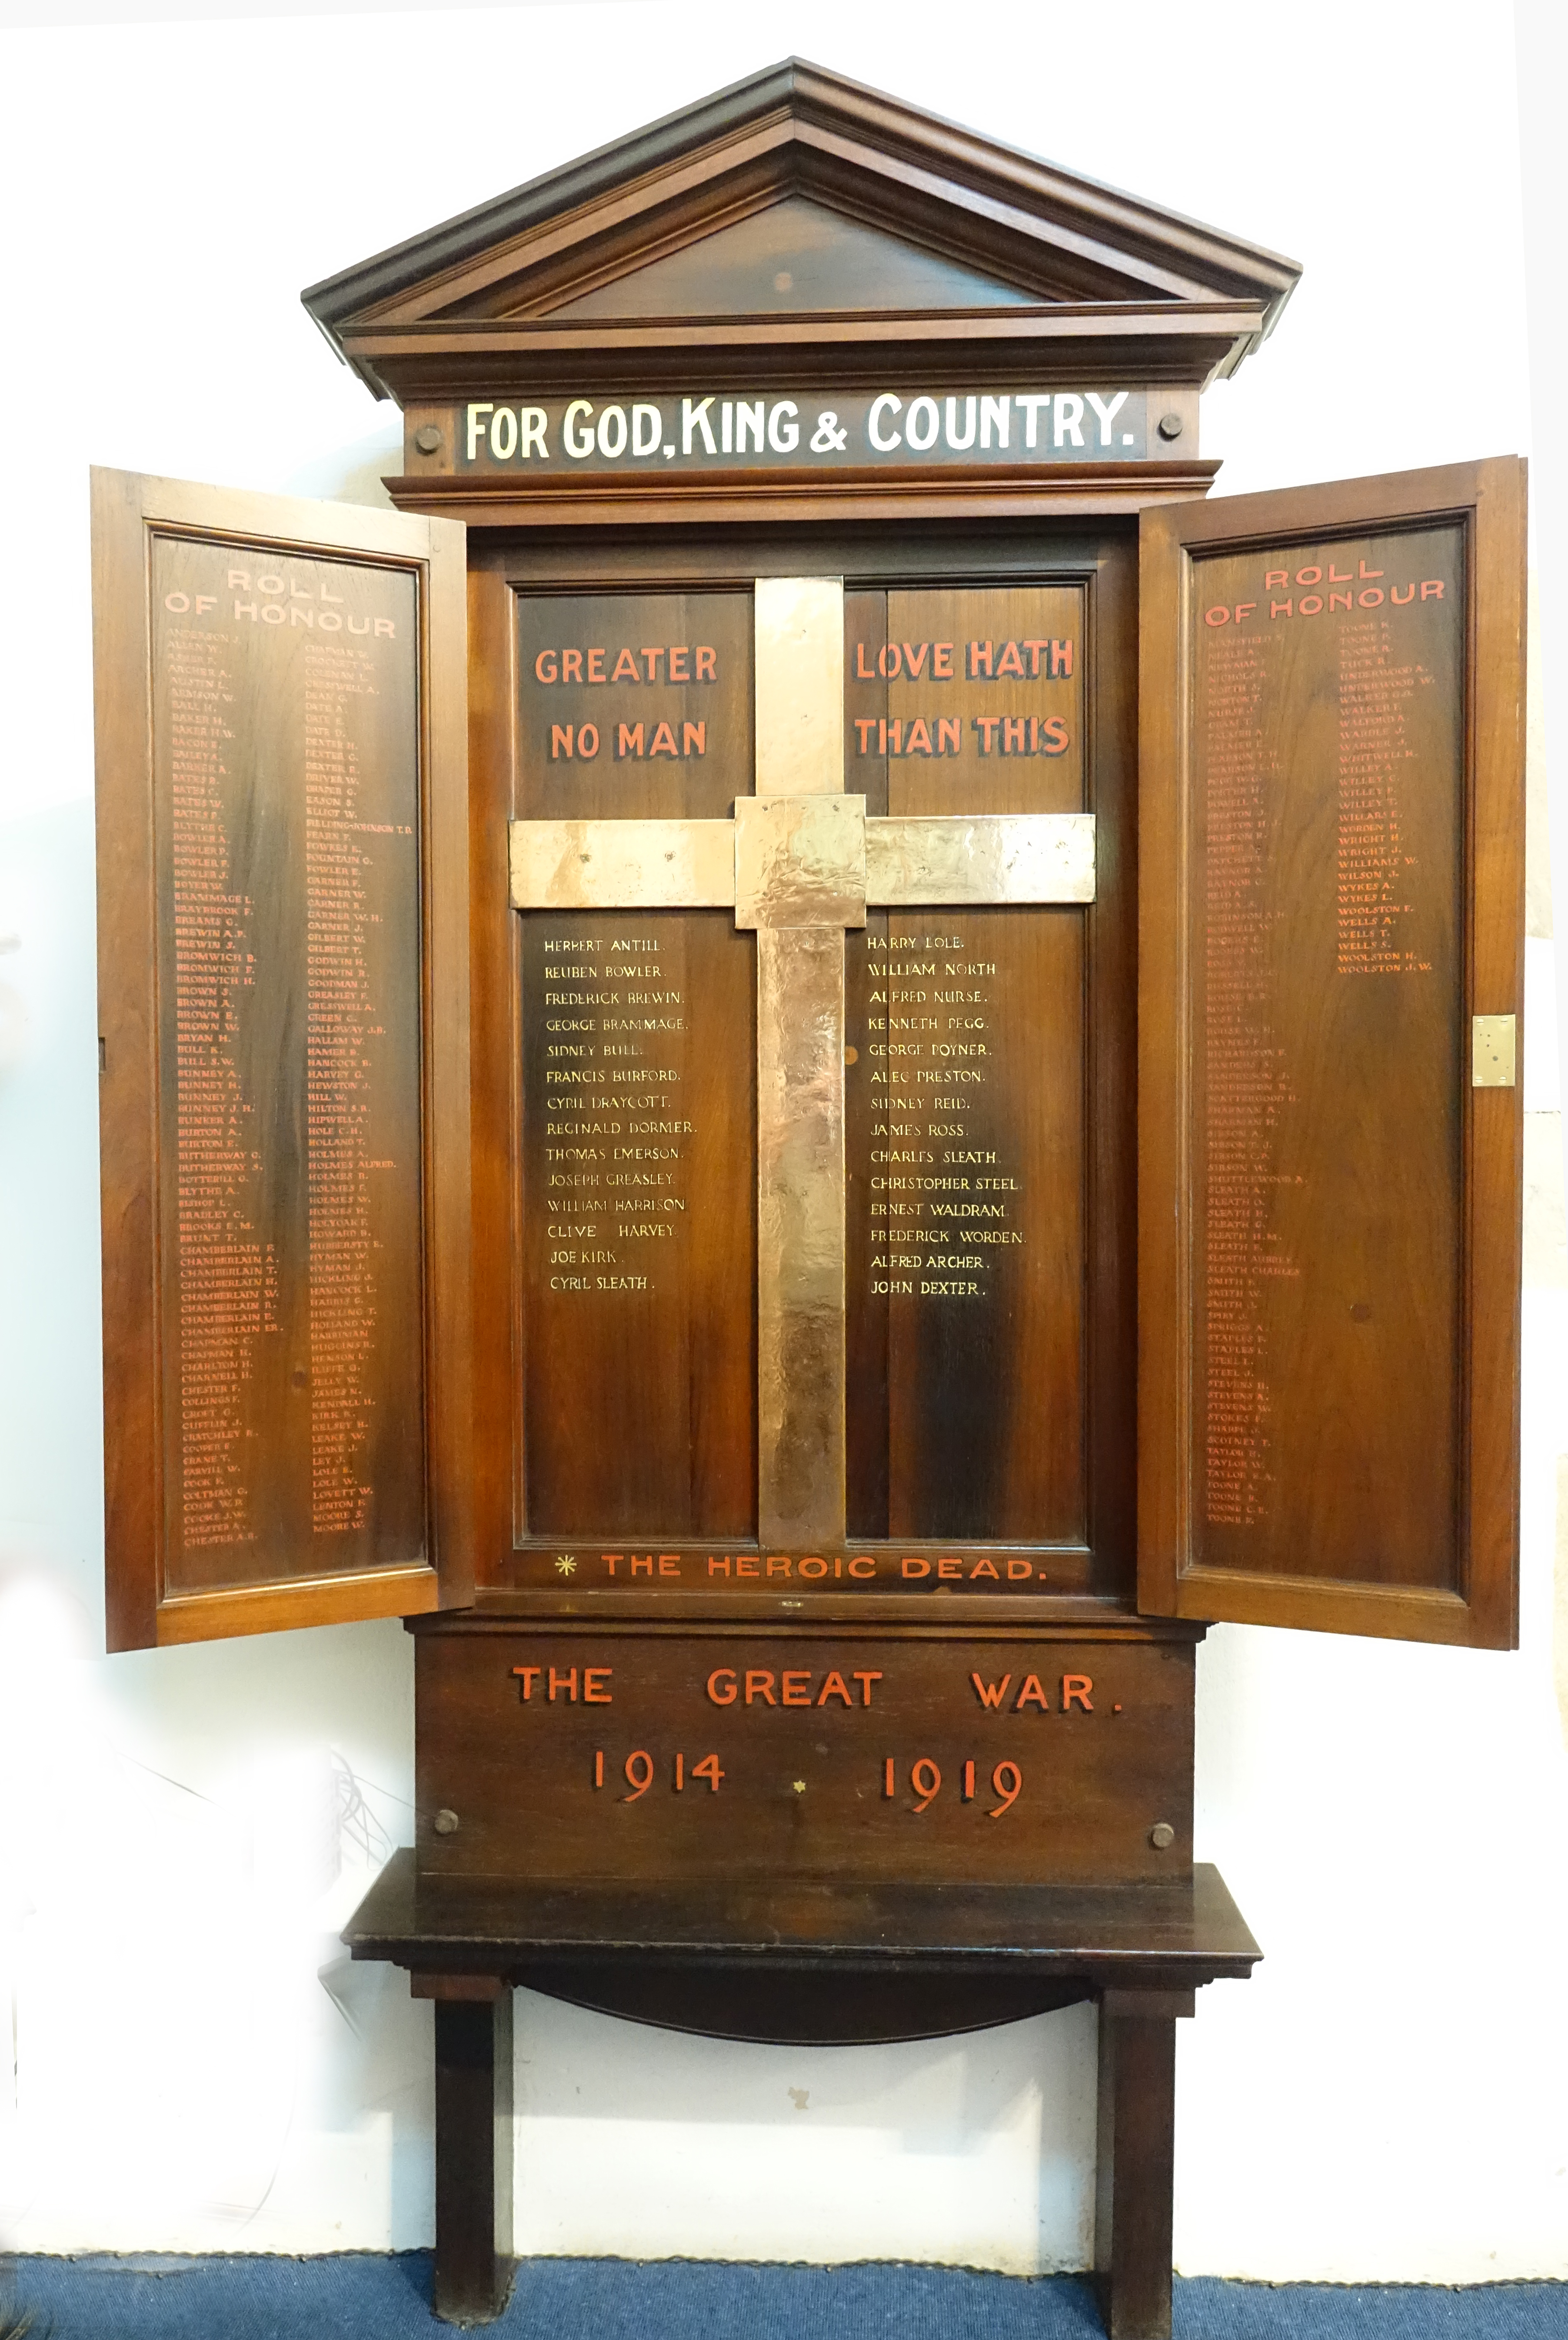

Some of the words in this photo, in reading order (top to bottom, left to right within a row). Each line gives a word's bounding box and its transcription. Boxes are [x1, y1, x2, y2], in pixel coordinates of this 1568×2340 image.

[467, 403, 550, 459] FOR
[682, 397, 800, 455] KING
[811, 411, 848, 453] &
[865, 392, 1135, 452] COUNTRY.
[1265, 559, 1384, 590] ROLL
[227, 570, 344, 603] ROLL
[1204, 603, 1256, 627] OF
[1270, 580, 1445, 619] HONOUR
[164, 592, 217, 616] OF
[234, 600, 396, 639] HONOUR
[535, 646, 717, 684] GREATER
[856, 642, 954, 679] LOVE
[970, 639, 1073, 677] HATH
[551, 723, 600, 758] NO
[618, 721, 706, 757] MAN
[854, 717, 962, 754] THAN
[977, 716, 1070, 753] THIS
[545, 940, 603, 952] HERBERT
[611, 940, 665, 951] ANTILL.
[868, 937, 916, 949] HARRY
[545, 967, 597, 979] REUBEN
[606, 966, 667, 977] BOWLER.
[868, 964, 935, 975] WILLIAM
[945, 963, 996, 975] NORTH
[546, 993, 619, 1005] FREDERICK
[628, 992, 685, 1004] BREWIN.
[869, 991, 926, 1003] ALFRED
[934, 991, 988, 1002] NURSE.
[546, 1019, 596, 1031] GEORGE
[603, 1019, 688, 1030] BRAMMAGE.
[868, 1018, 938, 1029] KENNETH
[949, 1018, 989, 1029] PEGG.
[547, 1045, 596, 1057] SIDNEY
[603, 1045, 643, 1055] BULL.
[869, 1045, 924, 1056] GEORGE
[932, 1044, 992, 1056] POYNER.
[546, 1071, 605, 1083] FRANCIS
[613, 1070, 681, 1081] BURFORD.
[870, 1071, 909, 1083] ALEC
[917, 1071, 985, 1082] PRESTON.
[548, 1098, 586, 1109] CYRIL
[593, 1096, 671, 1108] DRAYCOTT.
[870, 1098, 925, 1109] SIDNEY
[935, 1098, 970, 1109] REID.
[547, 1123, 621, 1135] REGINALD
[630, 1122, 697, 1134] DORMER.
[871, 1124, 921, 1136] JAMES
[929, 1124, 969, 1136] ROSS.
[546, 1148, 606, 1160] THOMAS
[614, 1148, 684, 1159] EMERSON.
[871, 1151, 933, 1163] CHARLES
[548, 1175, 599, 1186] JOSEPH
[606, 1173, 676, 1185] GREASLEY.
[871, 1178, 970, 1190] CHRISTOPHER
[548, 1200, 606, 1212] WILLIAM
[871, 1203, 924, 1215] ERNEST
[548, 1226, 596, 1238] CLIVE
[871, 1230, 949, 1242] FREDERICK
[960, 1231, 1027, 1243] WORDEN.
[550, 1251, 576, 1263] JOE
[871, 1256, 922, 1268] ALFRED
[926, 1256, 990, 1268] ARCHER.
[550, 1277, 591, 1289] CYRIL
[871, 1282, 912, 1294] JOHN
[921, 1282, 985, 1294] DEXTER.
[601, 1554, 682, 1577] THE
[708, 1555, 878, 1578] HEROIC
[901, 1557, 1046, 1581] DEAD.
[513, 1666, 613, 1704] THE
[707, 1668, 883, 1707] GREAT
[971, 1672, 1122, 1713] WAR.
[594, 1750, 725, 1803] 1914
[885, 1758, 1023, 1819] 1919
